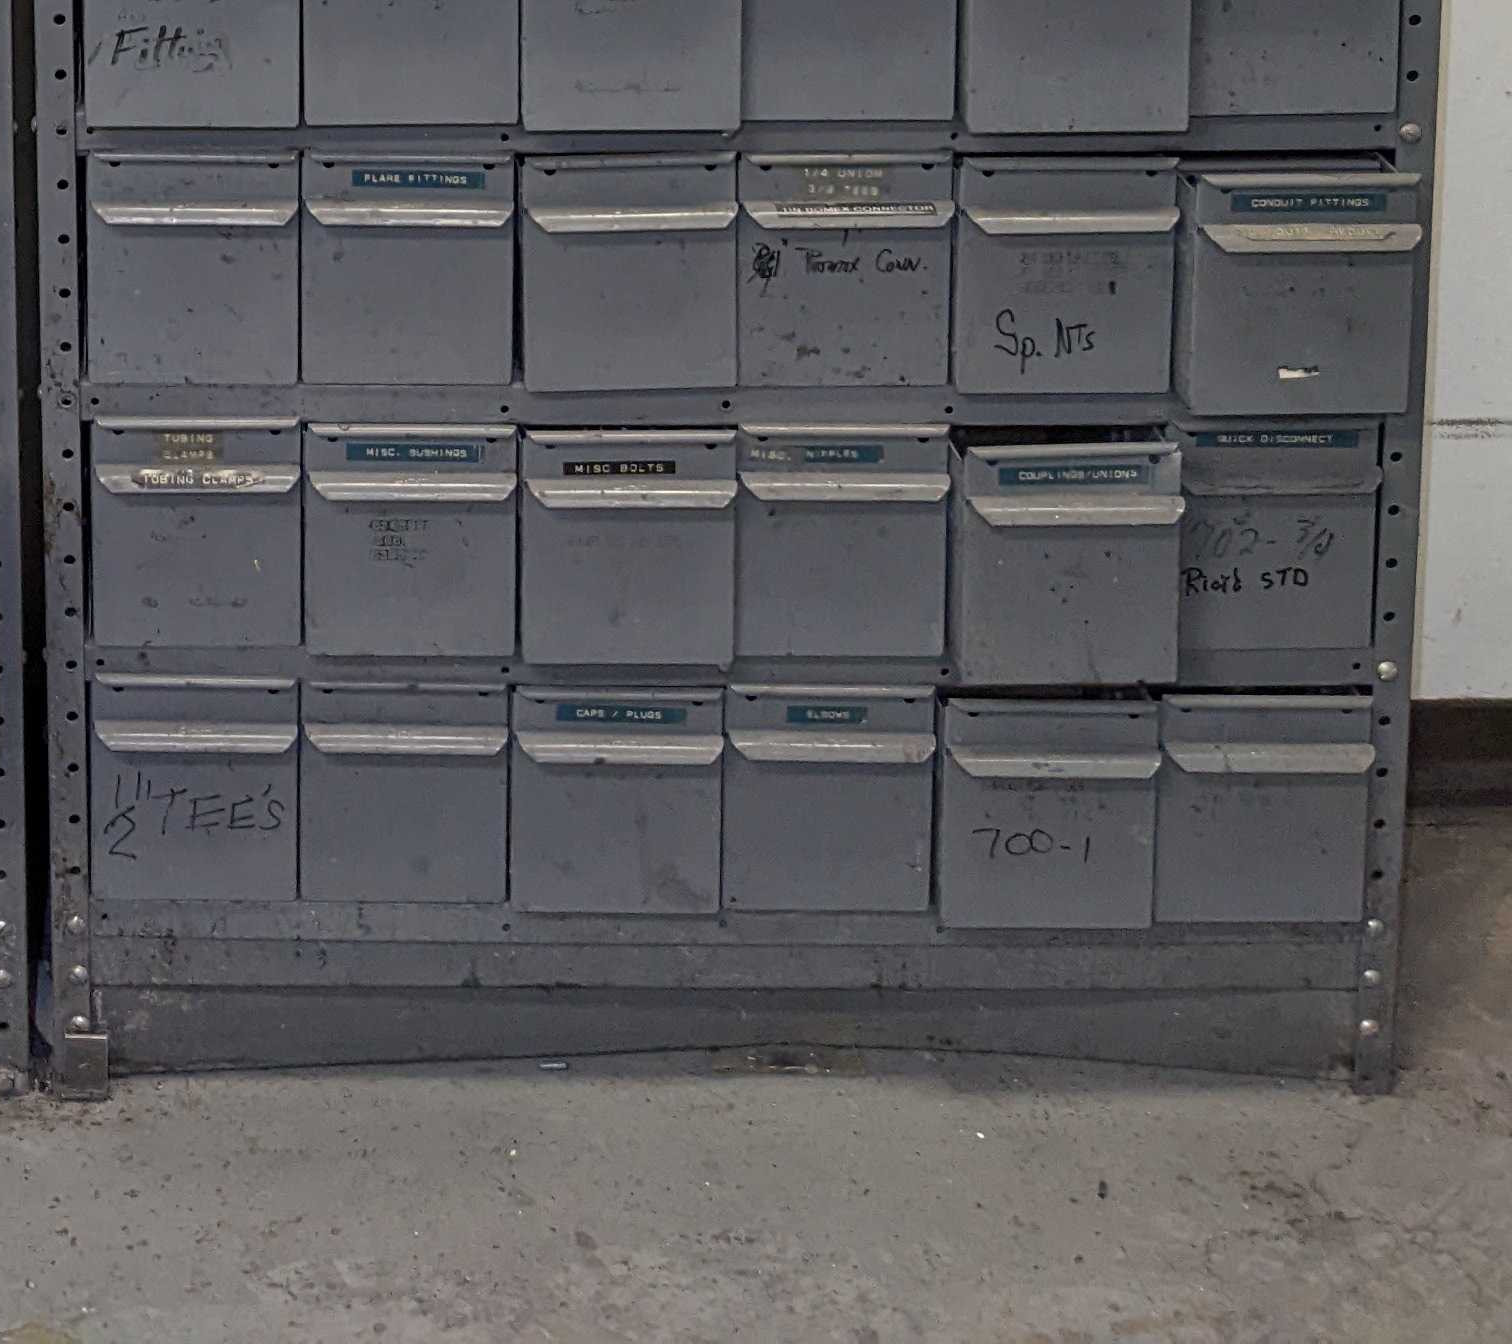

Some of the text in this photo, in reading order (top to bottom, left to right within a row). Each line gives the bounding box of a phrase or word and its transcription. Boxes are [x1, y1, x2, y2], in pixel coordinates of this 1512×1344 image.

[362, 173, 469, 186] FLARE FITTINGS
[574, 462, 665, 474] MISC BOLTS
[141, 472, 254, 486] TUBING CLAMPS
[972, 827, 1090, 863] 700-1
